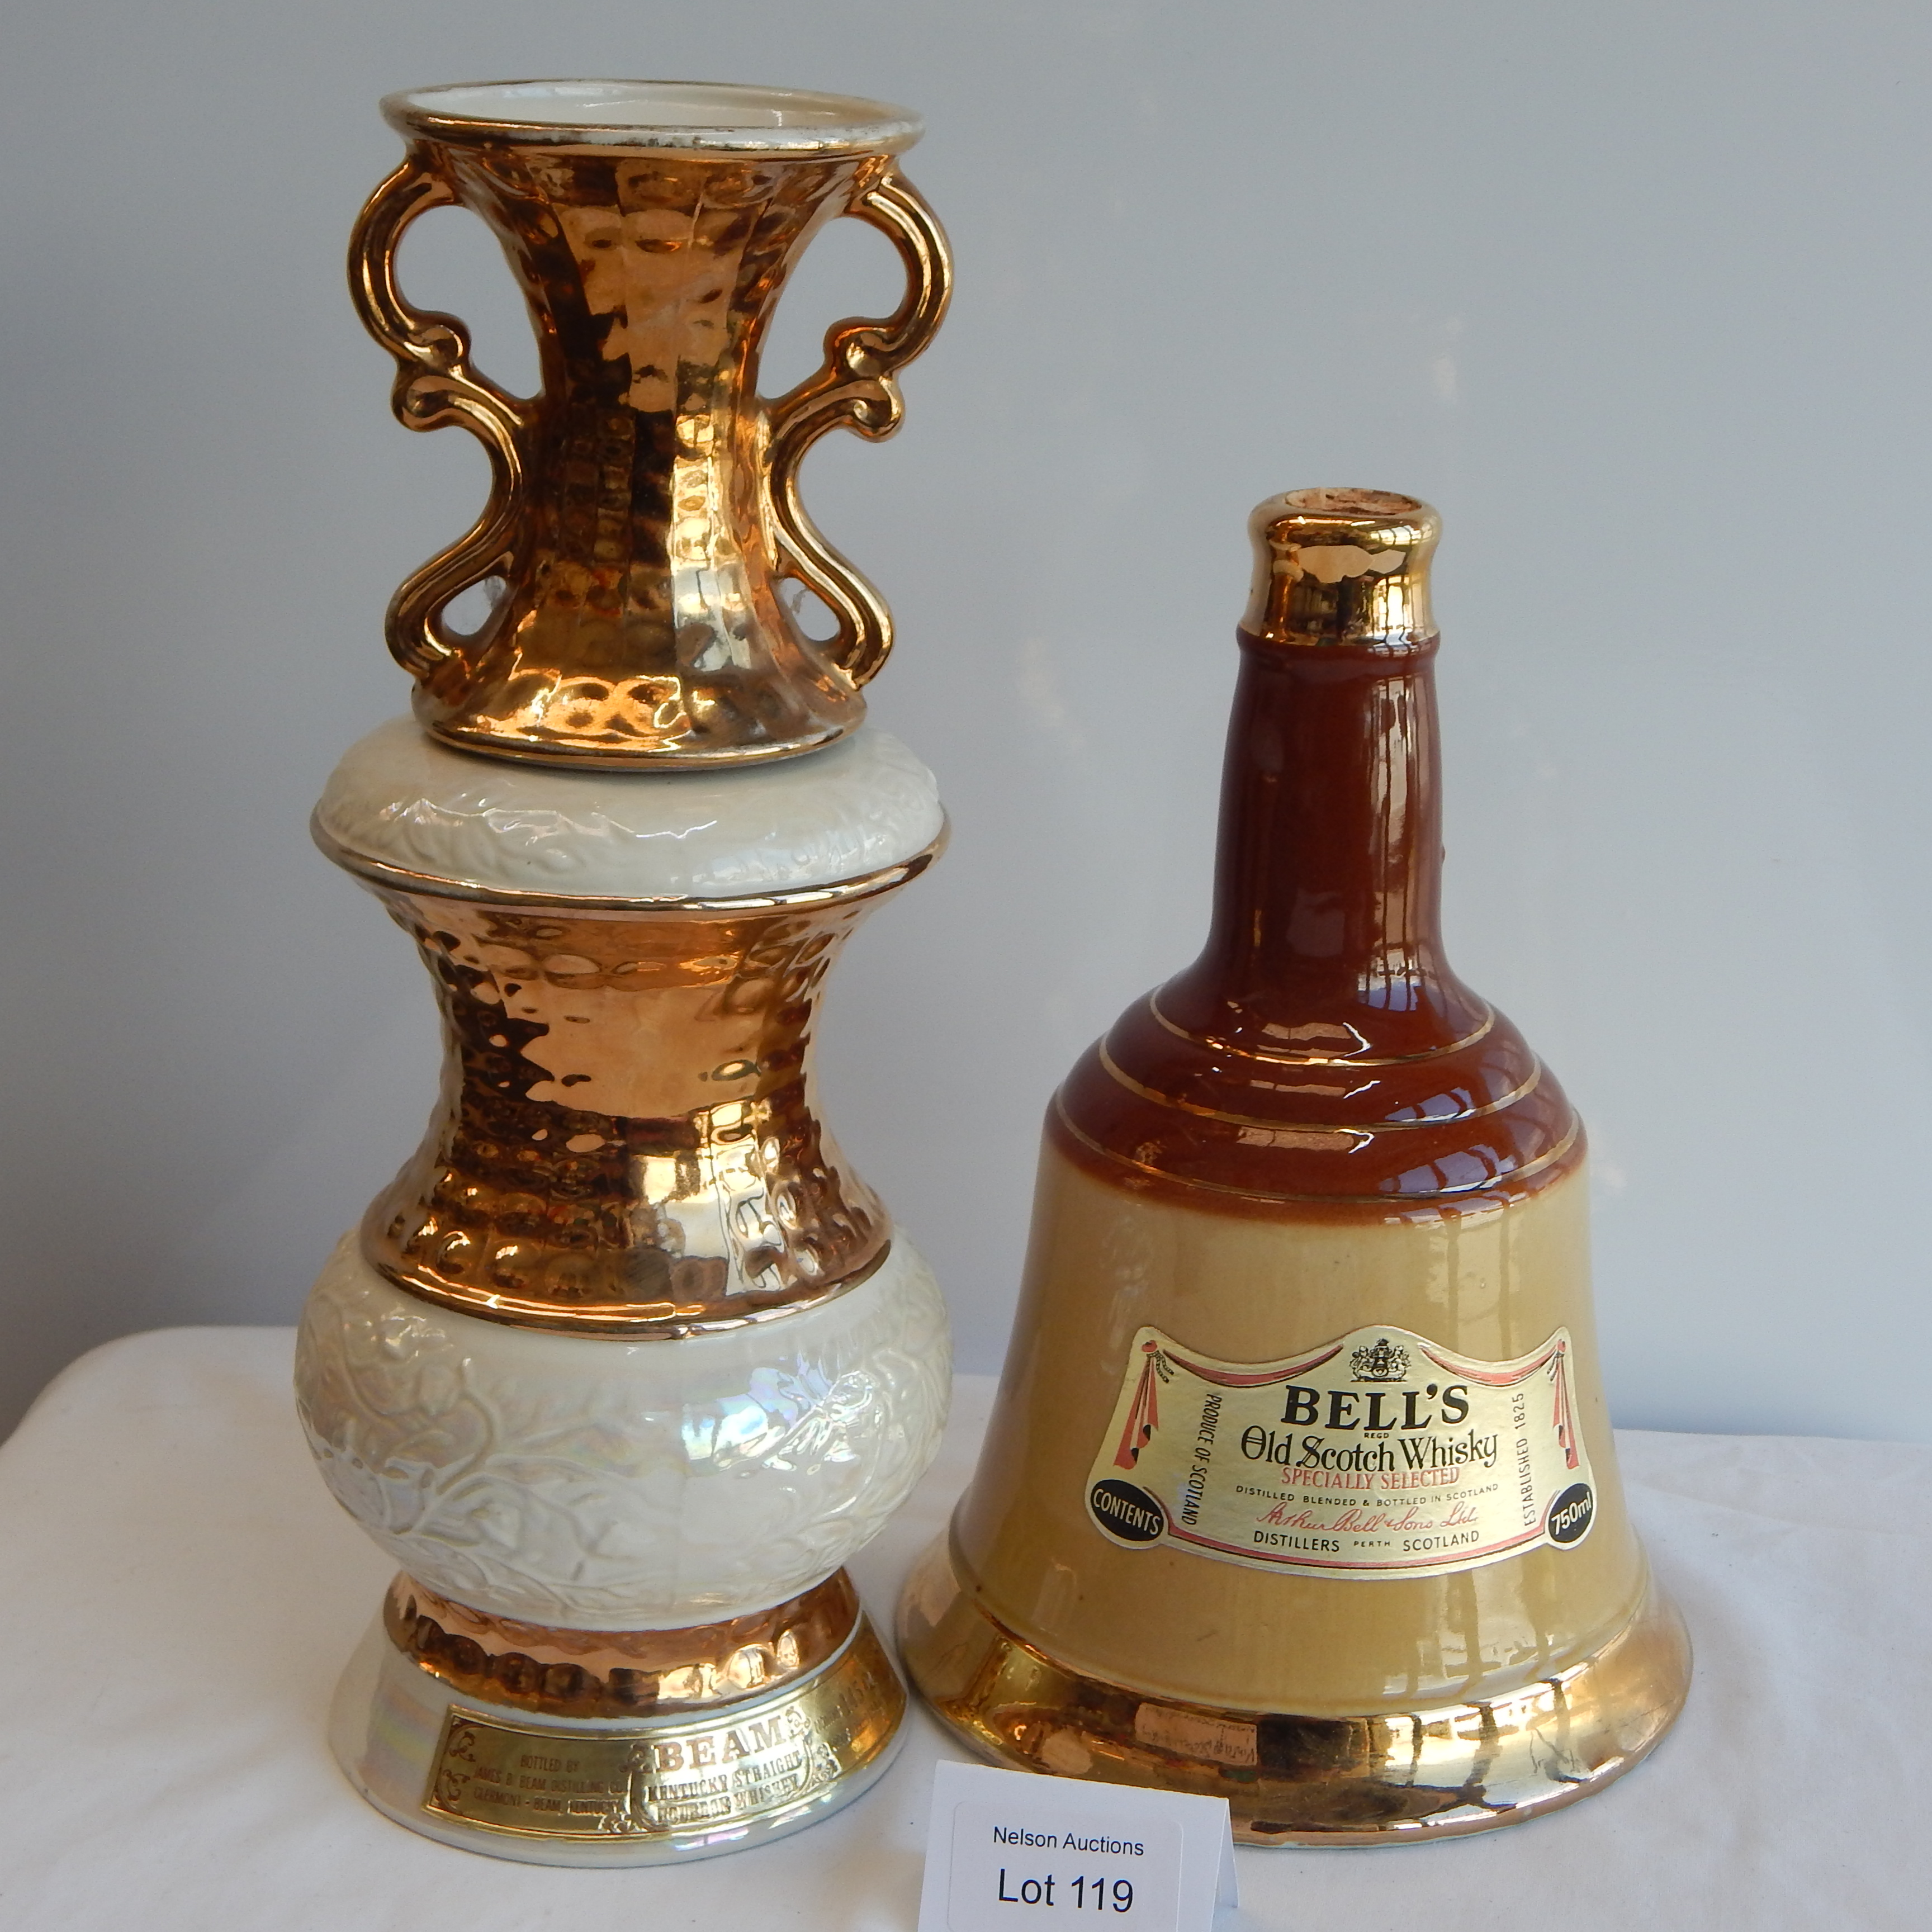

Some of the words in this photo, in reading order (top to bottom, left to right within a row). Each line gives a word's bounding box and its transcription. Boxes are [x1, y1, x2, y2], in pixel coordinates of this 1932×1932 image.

[1197, 1394, 1222, 1445] PRODUCE
[1280, 1383, 1469, 1431] BELL'S
[1512, 1393, 1526, 1429] 1825
[1194, 1447, 1211, 1464] OF
[1241, 1425, 1293, 1466] Old
[1296, 1436, 1395, 1472] Scotch
[1398, 1429, 1498, 1470] Whisky
[1181, 1465, 1208, 1525] SCOTLAND
[1236, 1485, 1295, 1502] DISTILLED
[1303, 1495, 1357, 1507] BLENDED
[1377, 1497, 1427, 1507] BOTTLED
[1446, 1483, 1499, 1502] SCOTLAND
[1281, 1467, 1376, 1490] SPECIALLY
[1380, 1466, 1460, 1490] SELECTED
[1516, 1438, 1536, 1527] ESTABLISHED
[1093, 1488, 1161, 1535] CONTENTS
[1257, 1501, 1328, 1531] Arthur
[1327, 1508, 1385, 1533] Bell
[1393, 1506, 1433, 1532] Sons
[1551, 1491, 1592, 1536] 750ml
[1254, 1530, 1340, 1552] DISTILLERS
[1403, 1530, 1480, 1552] SCOTLAND
[520, 1755, 560, 1772] BOTTLED
[732, 1750, 803, 1788] STRAIGHT
[993, 1826, 1057, 1848] Nelson
[1062, 1832, 1144, 1857] Auctions
[998, 1868, 1055, 1906] Lot
[1071, 1875, 1134, 1913] 119
